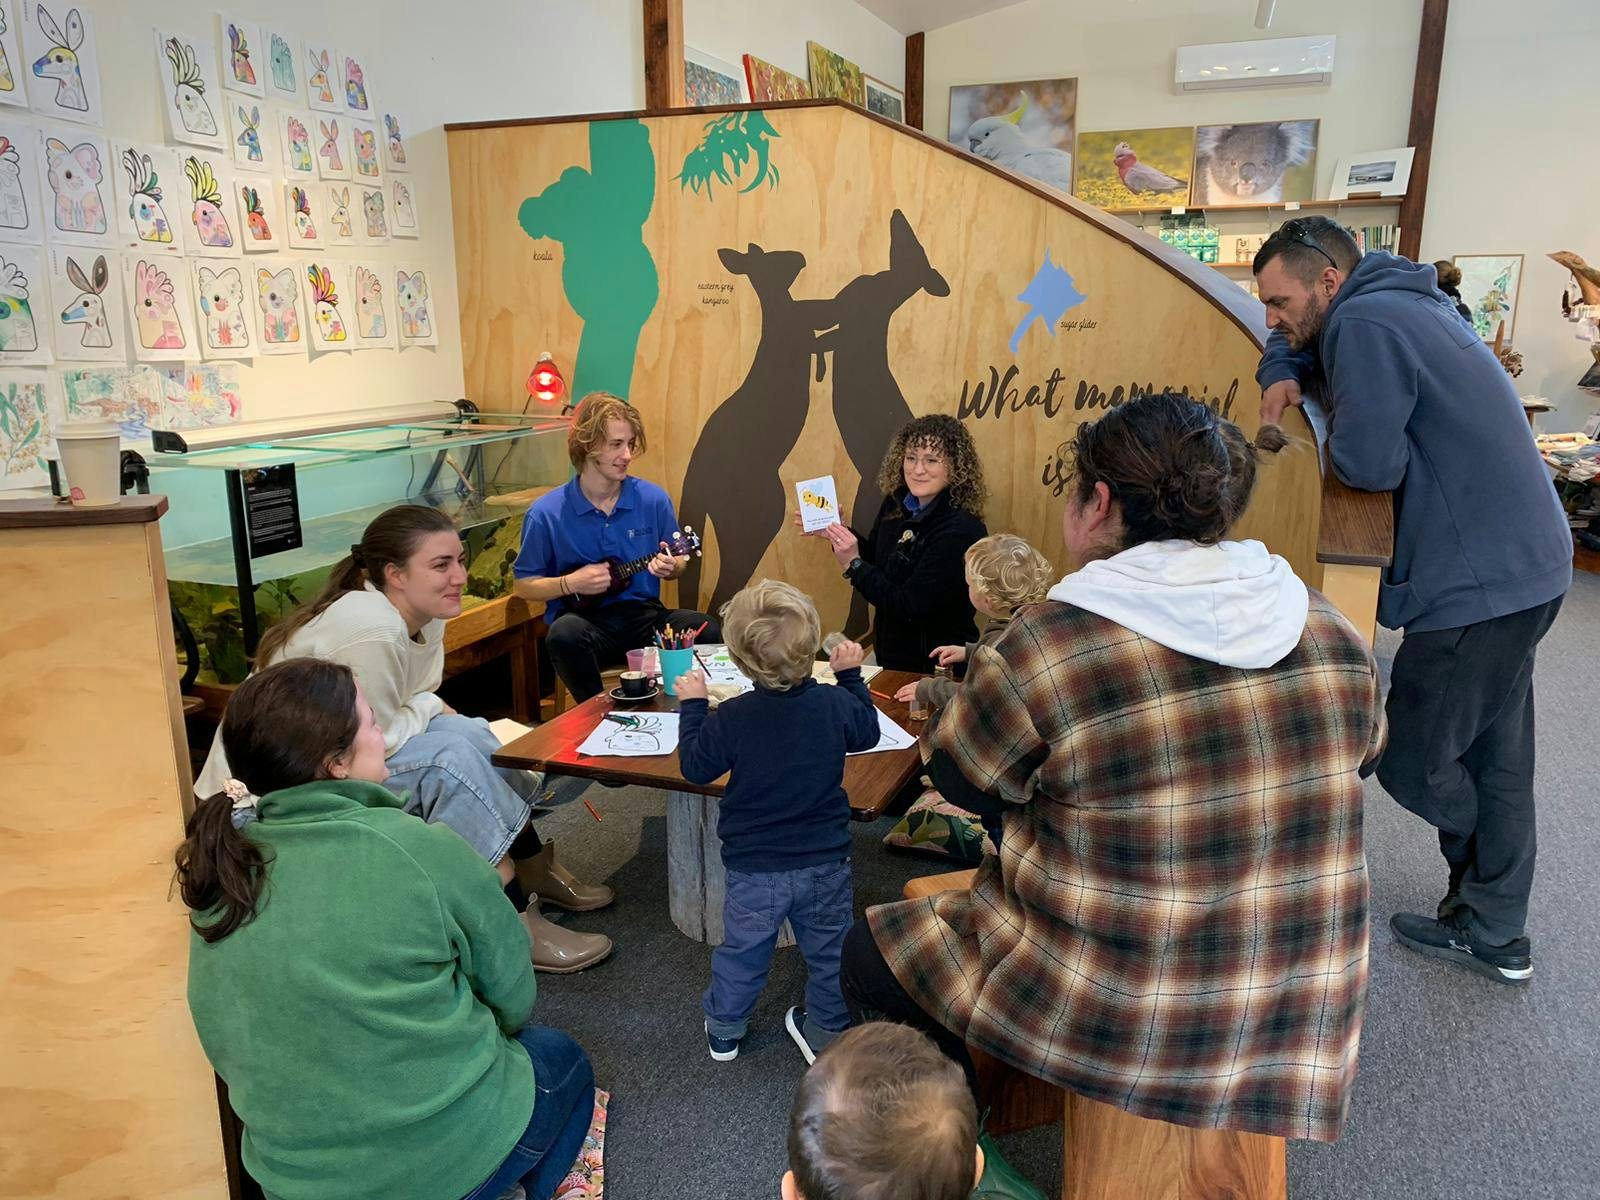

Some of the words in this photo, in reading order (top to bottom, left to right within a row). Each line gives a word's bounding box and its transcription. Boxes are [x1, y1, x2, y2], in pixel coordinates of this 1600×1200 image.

[533, 249, 553, 261] koala
[720, 283, 734, 293] grey
[702, 296, 729, 307] kangaroo
[1060, 320, 1078, 331] sugar
[1078, 317, 1097, 332] glider
[957, 364, 1066, 420] What
[1042, 455, 1074, 498] is
